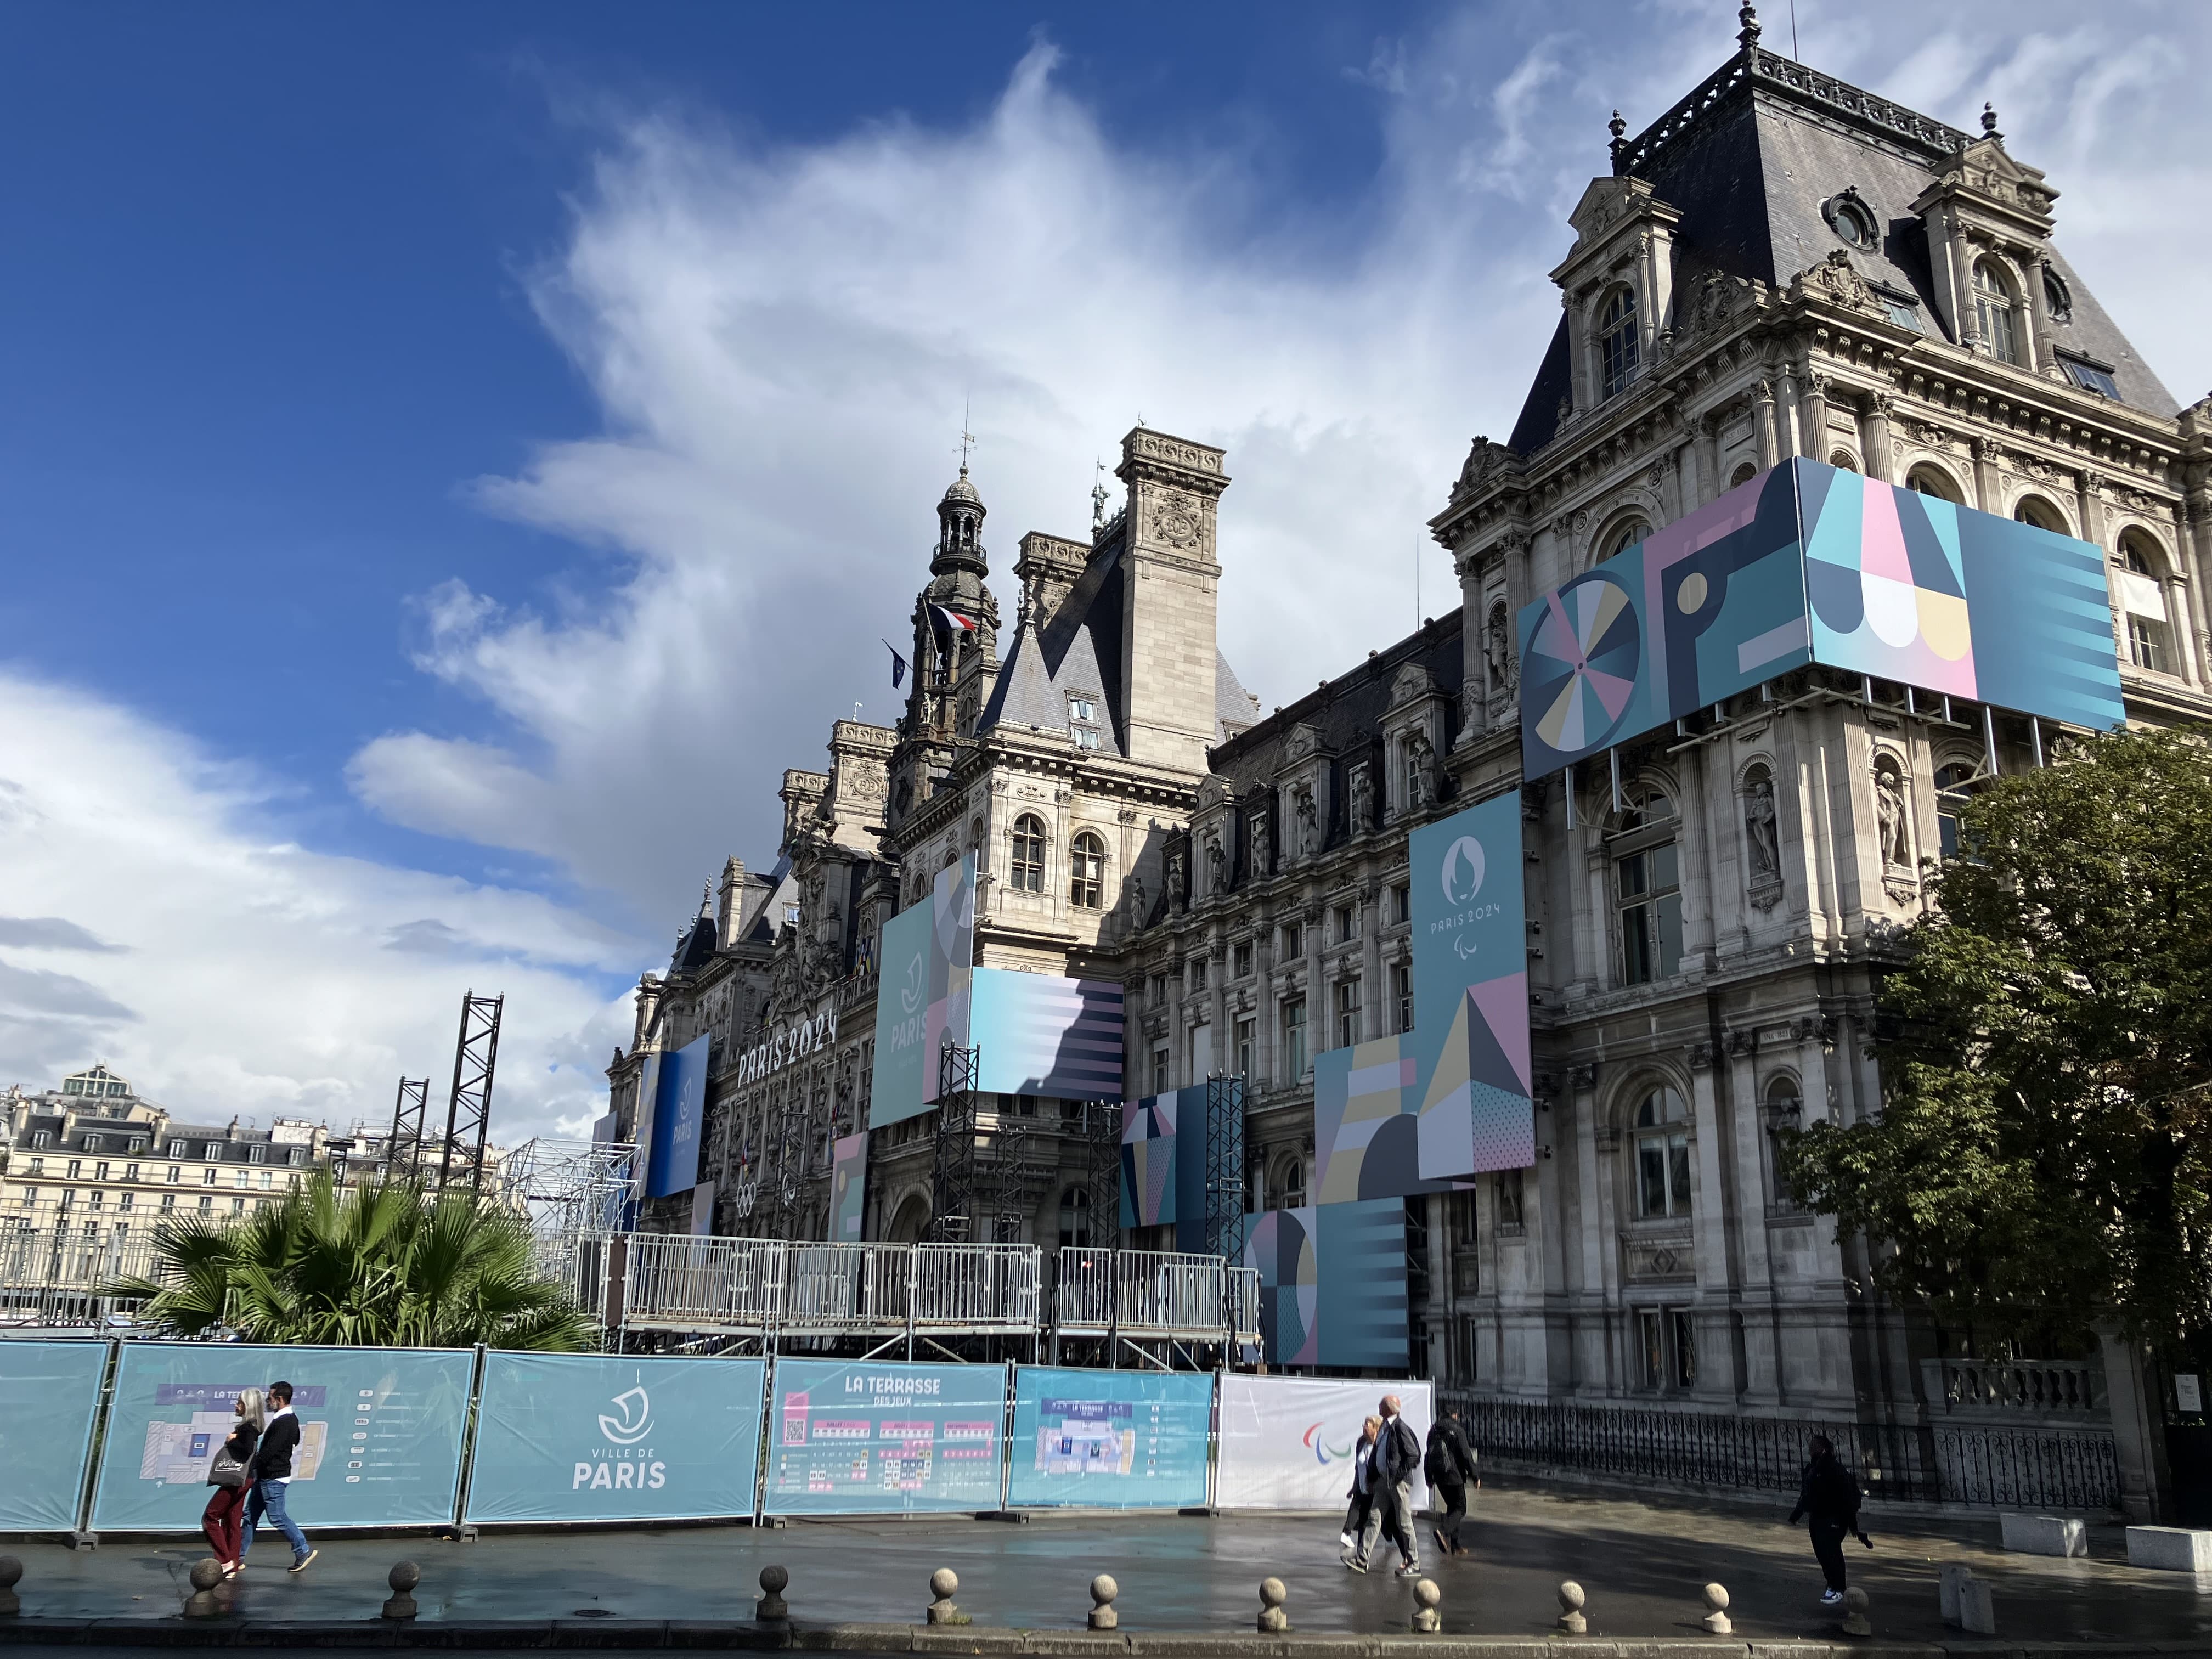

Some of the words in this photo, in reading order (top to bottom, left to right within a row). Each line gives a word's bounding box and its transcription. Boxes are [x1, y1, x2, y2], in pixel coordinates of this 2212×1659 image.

[1431, 914, 1464, 935] PARIS
[1467, 902, 1500, 923] 2024
[891, 1011, 927, 1053] PARIS
[738, 1035, 783, 1088] PARIS
[787, 1008, 837, 1065] 2024
[673, 1120, 692, 1146] PARIS
[845, 1375, 864, 1393] LA
[867, 1376, 941, 1395] TERRASSE
[873, 1395, 890, 1407] DES
[889, 1396, 912, 1408] JEUX
[592, 1448, 630, 1458] VILLE
[637, 1448, 654, 1458] DE
[572, 1461, 667, 1490] PARIS
